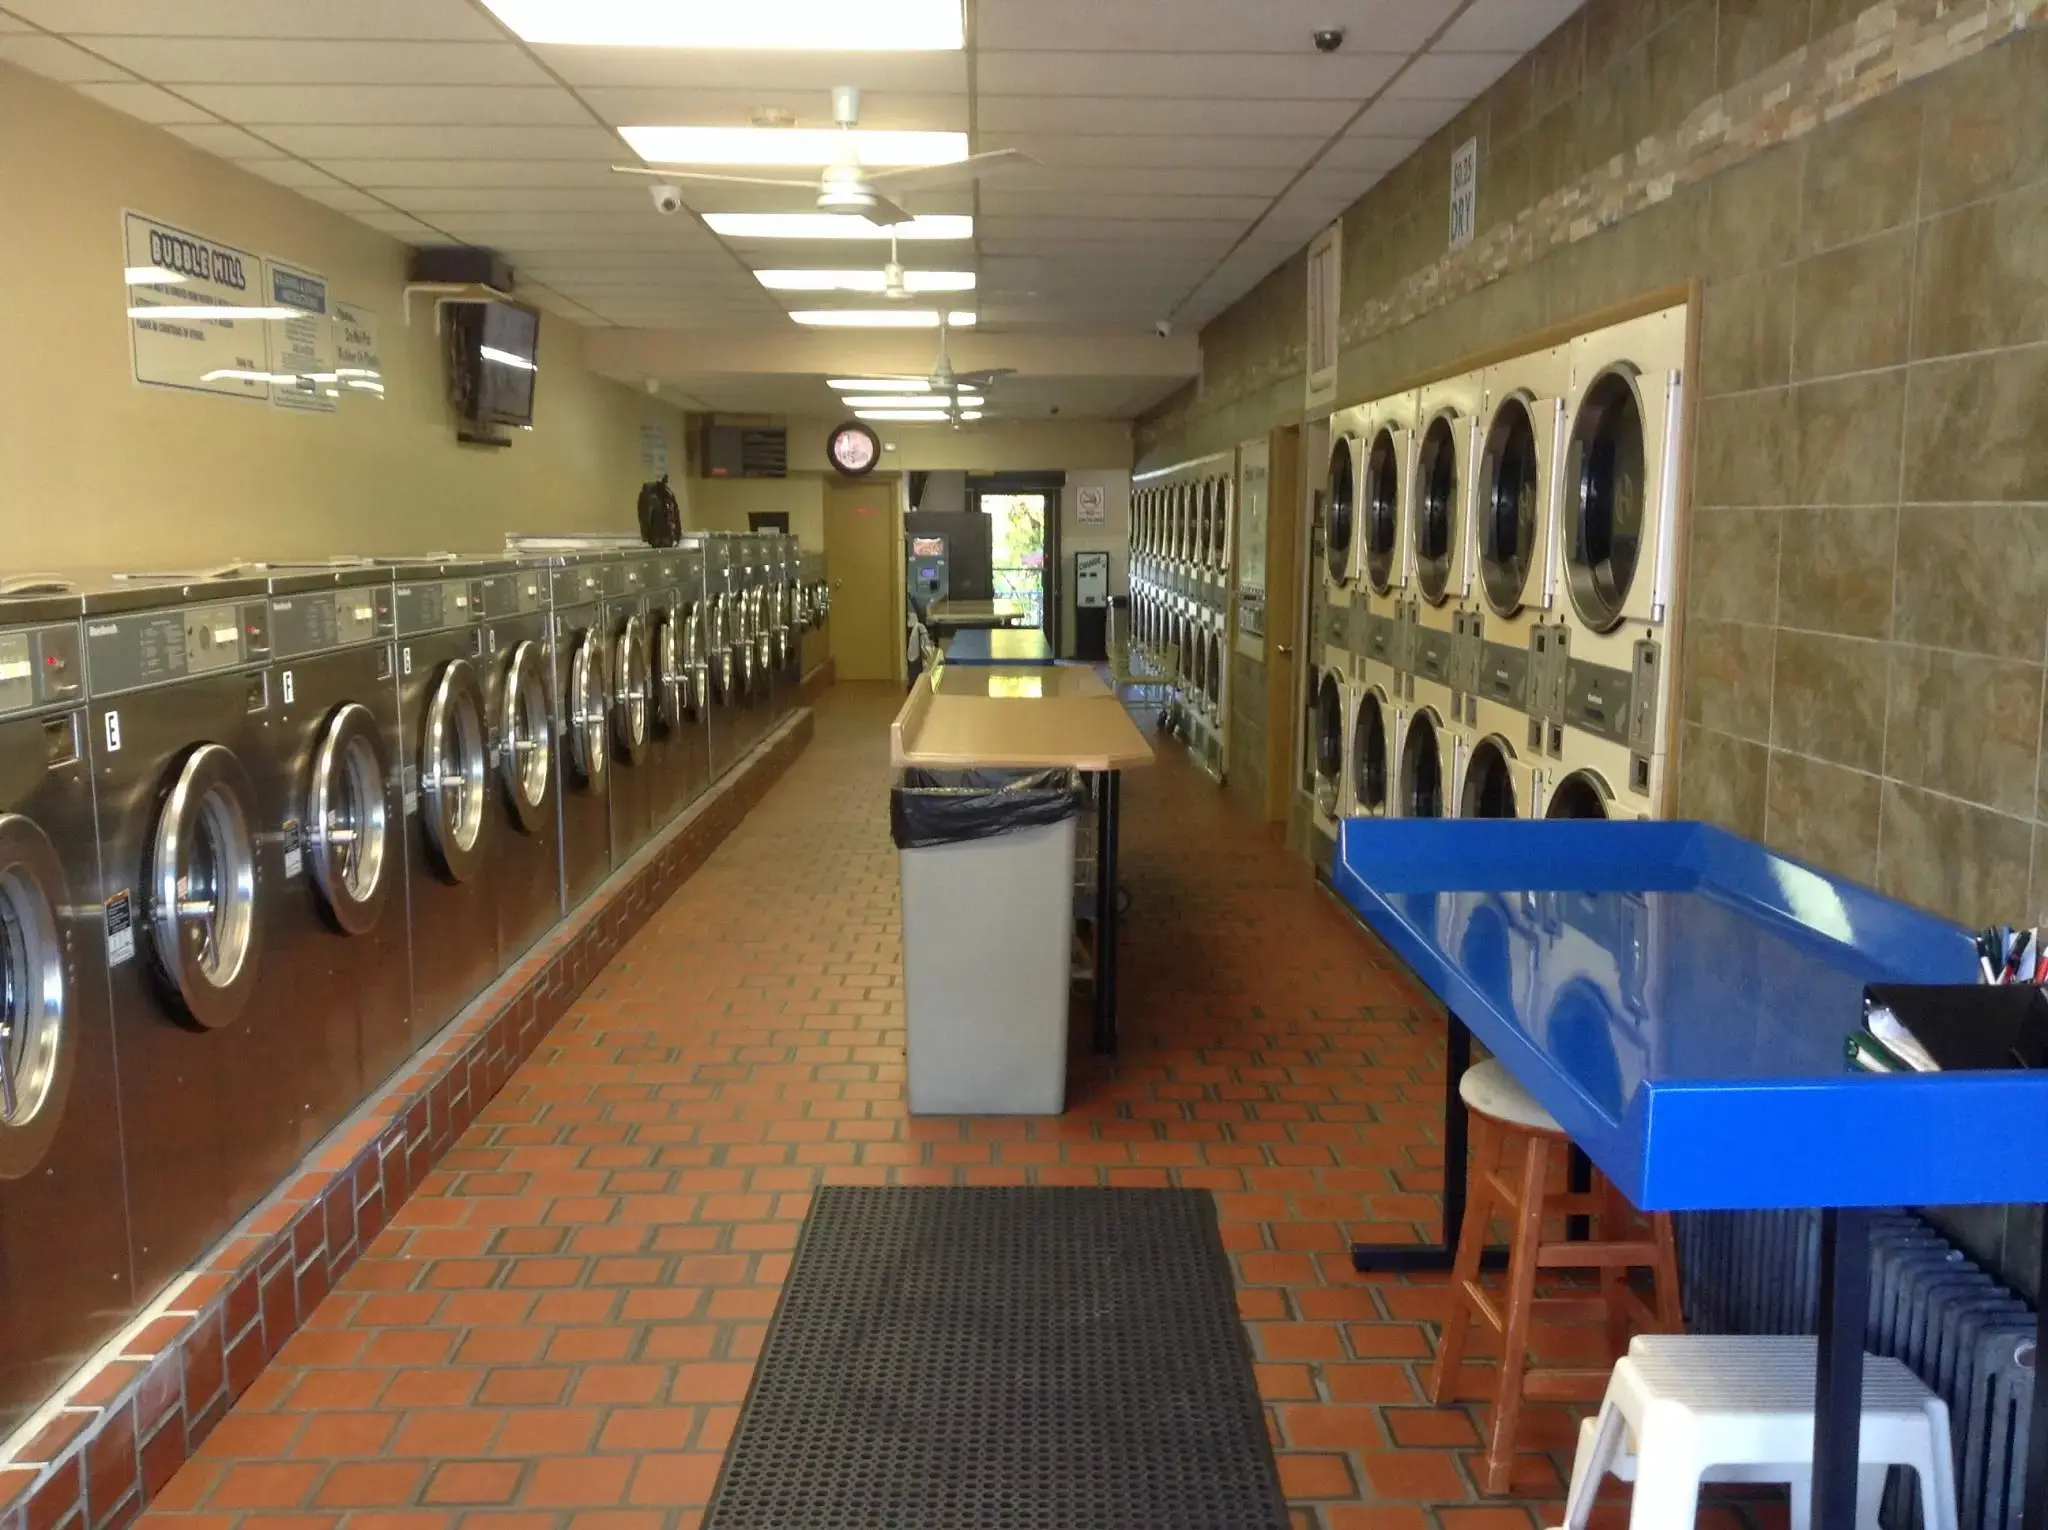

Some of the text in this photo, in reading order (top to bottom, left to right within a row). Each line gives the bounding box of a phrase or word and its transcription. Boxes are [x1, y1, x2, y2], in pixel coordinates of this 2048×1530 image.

[1451, 192, 1472, 243] DRY
[150, 229, 211, 280] BUBBLE
[108, 714, 117, 747] E
